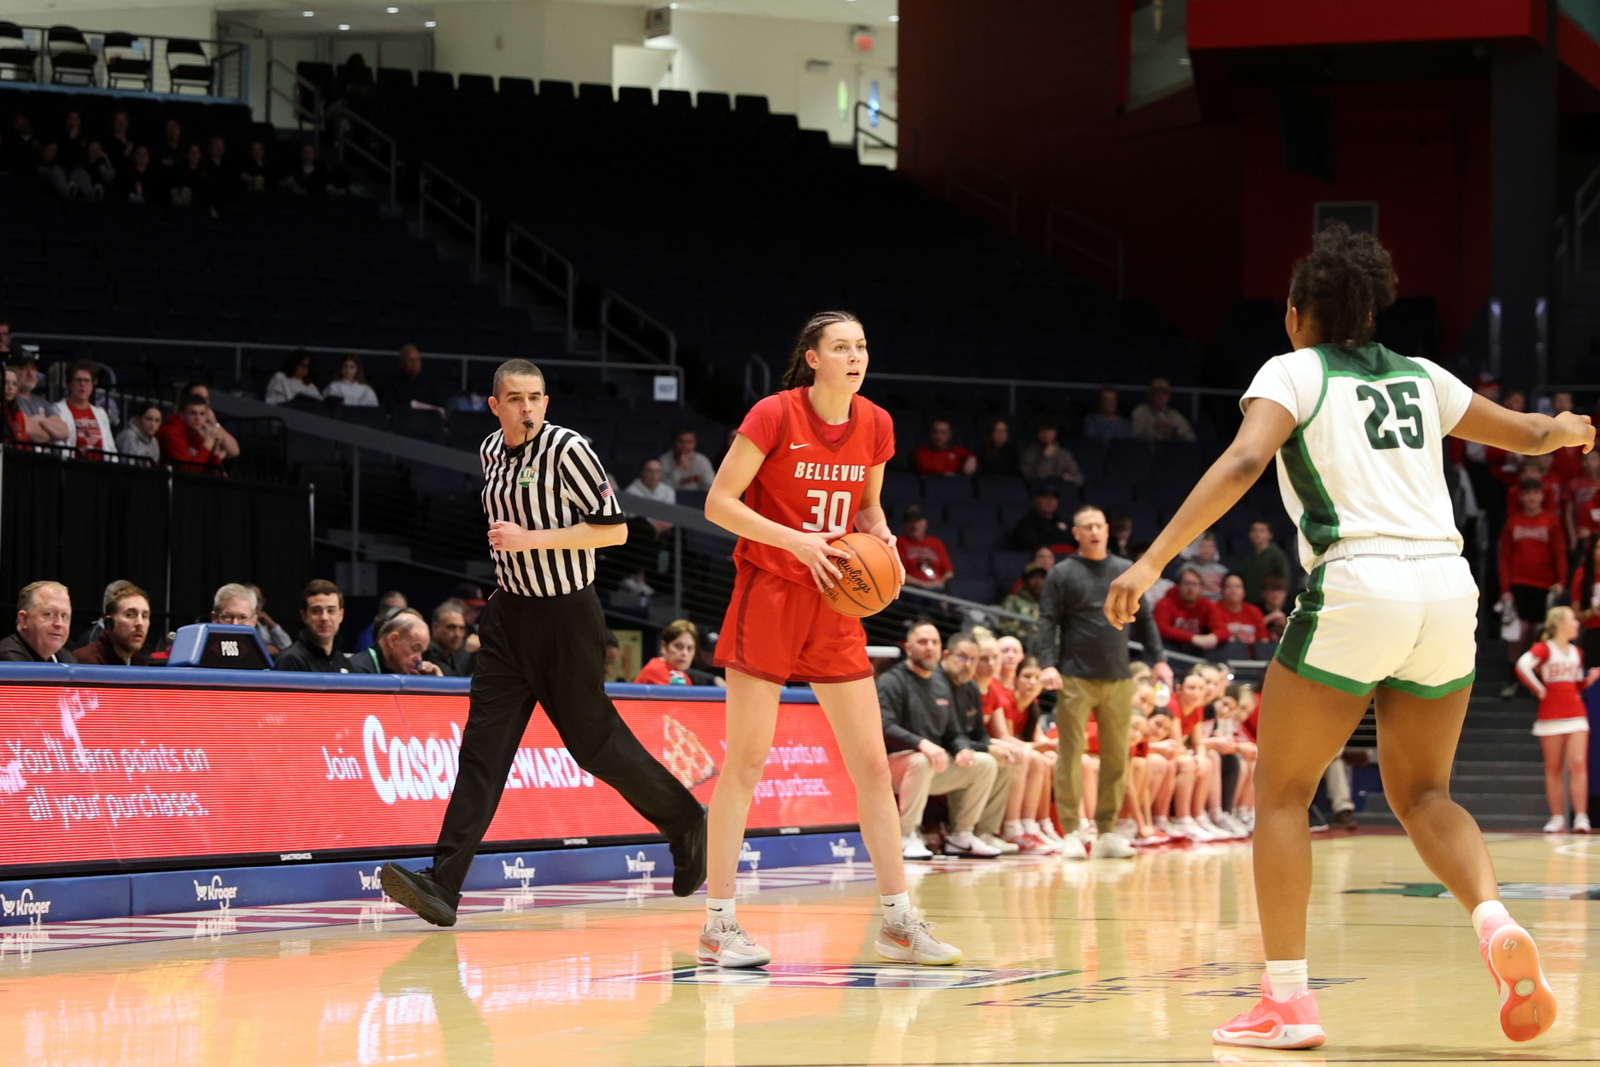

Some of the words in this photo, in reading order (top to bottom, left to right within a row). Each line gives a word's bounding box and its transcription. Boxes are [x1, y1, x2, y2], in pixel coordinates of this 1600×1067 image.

[1356, 381, 1424, 449] 25
[794, 461, 867, 482] BELLEVUE
[802, 489, 852, 533] 30
[71, 748, 119, 773] earn
[119, 739, 183, 782] points
[183, 748, 211, 773] on
[321, 745, 364, 781] Join
[504, 747, 595, 789] EWARD
[27, 786, 53, 821] all
[55, 794, 101, 831] your
[104, 785, 210, 829] purchases.
[16, 888, 51, 925] Kroger
[207, 875, 238, 911] Kroger
